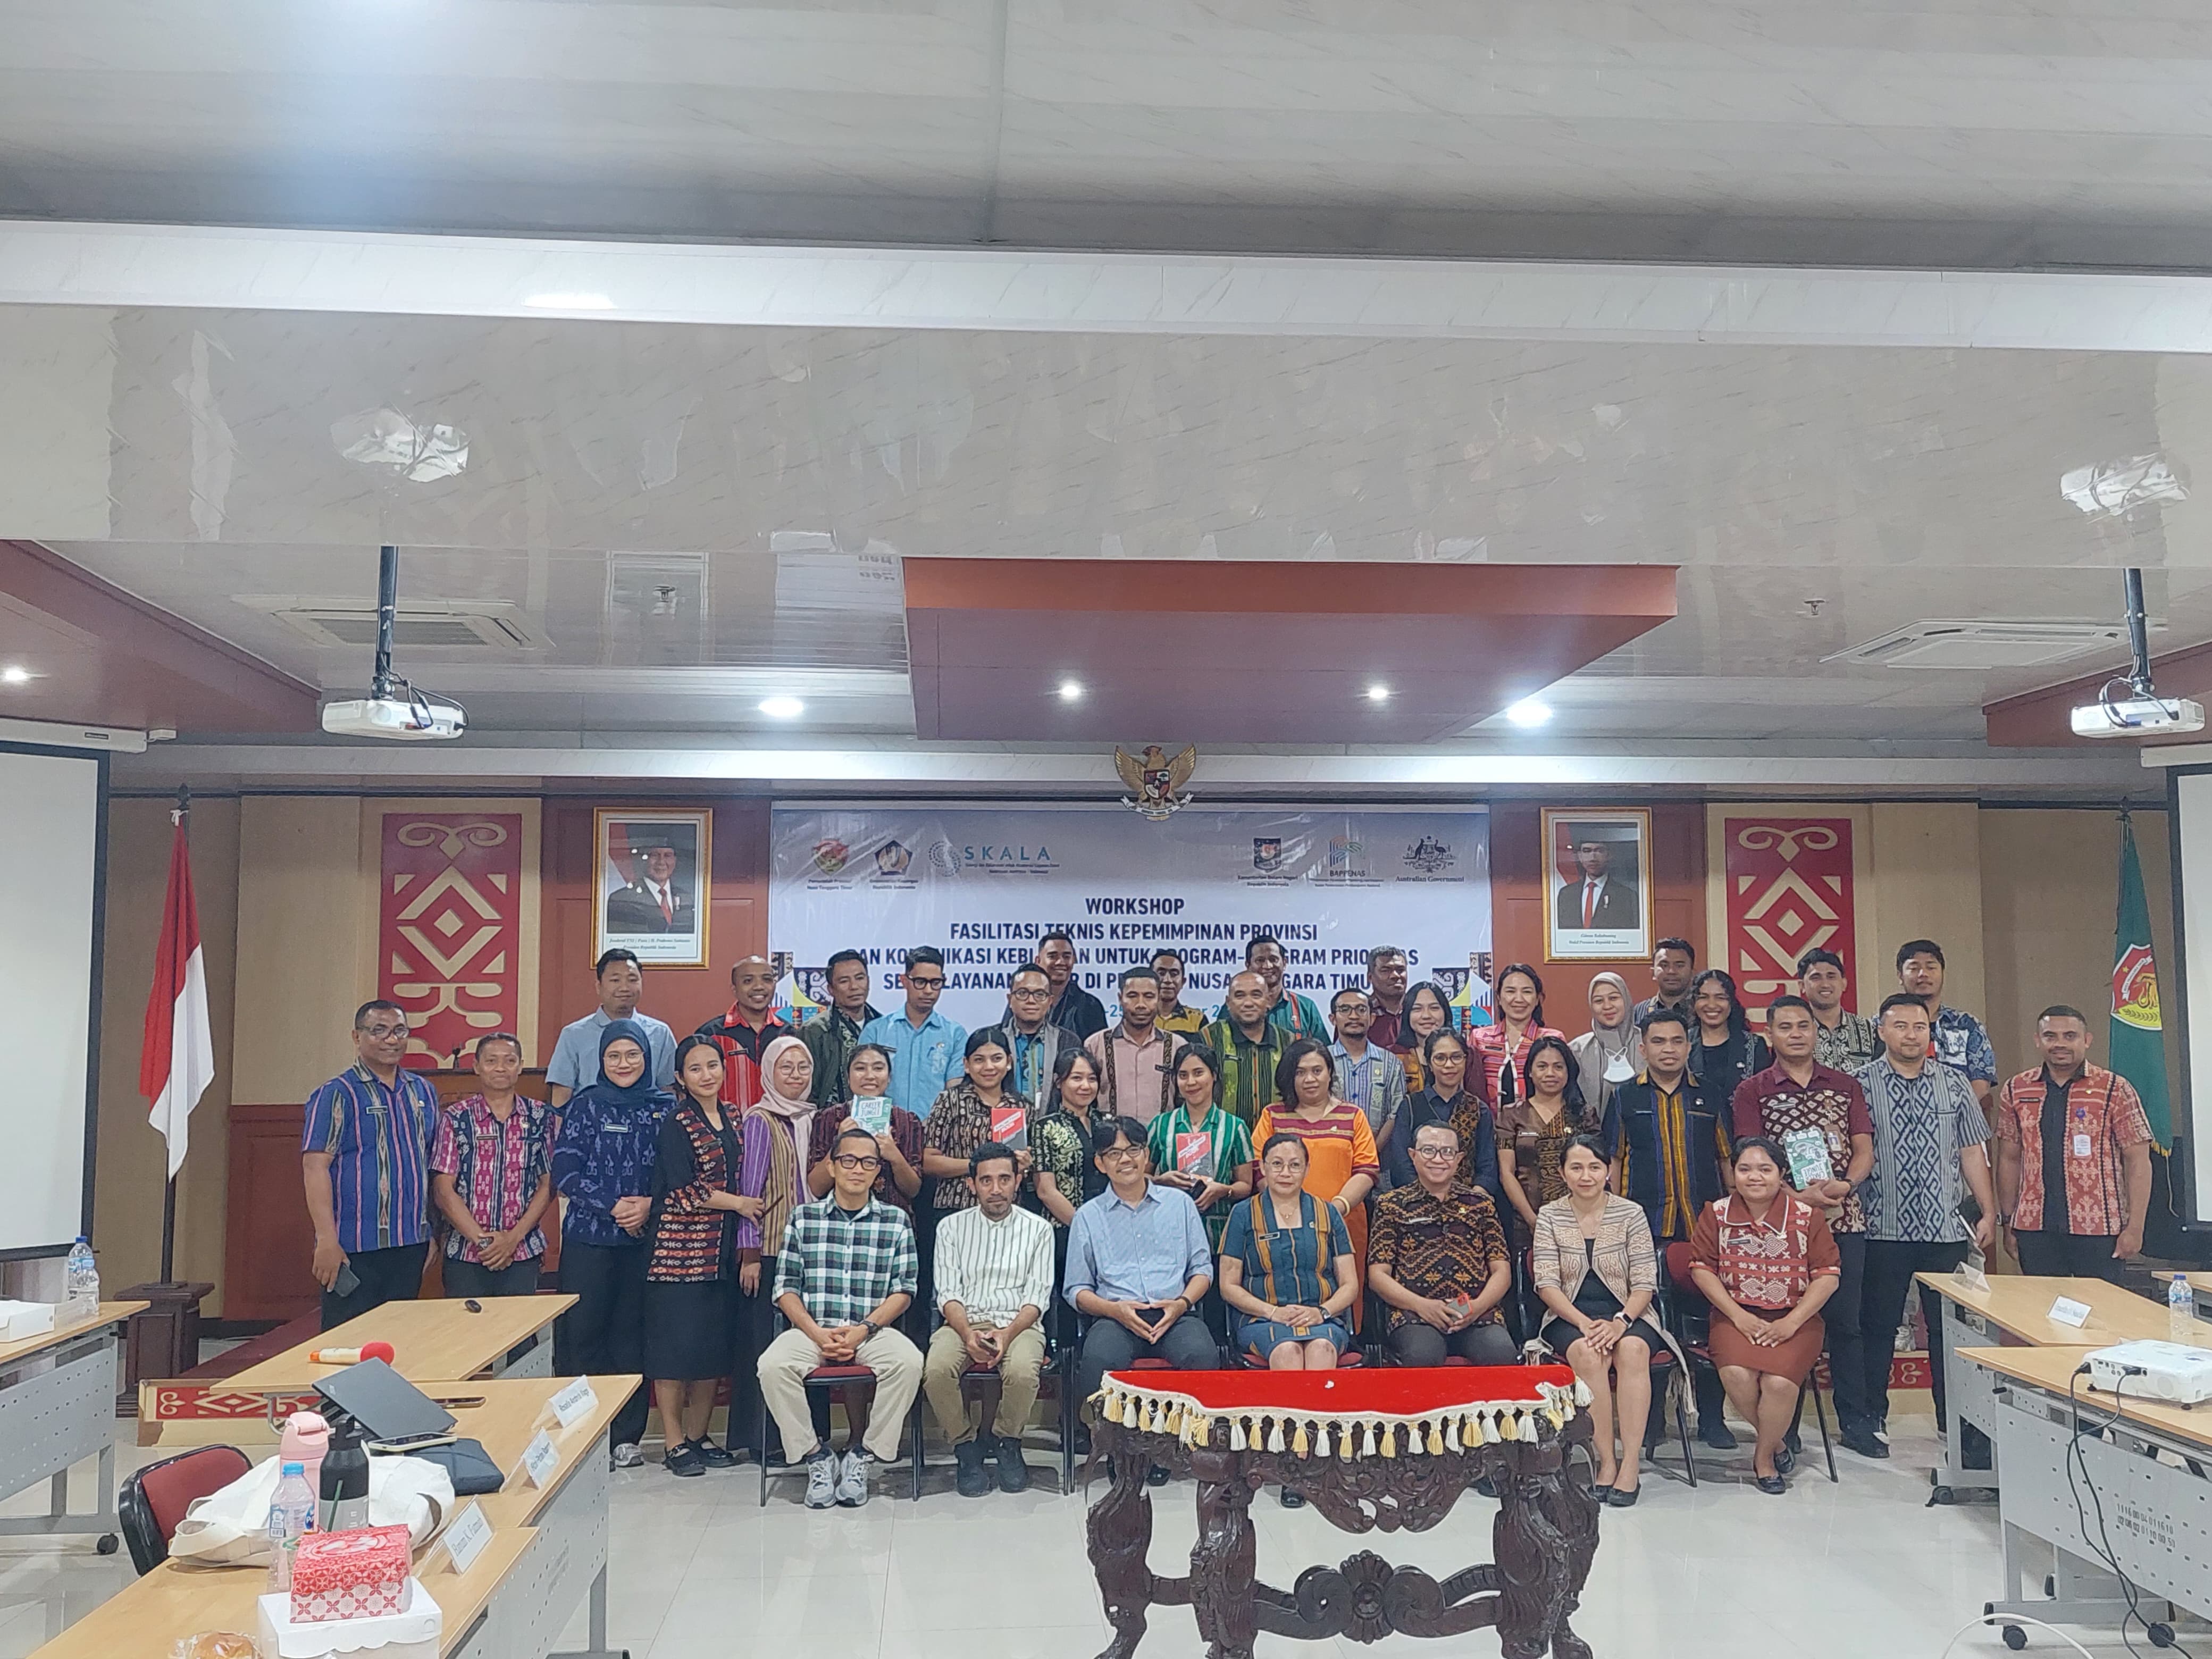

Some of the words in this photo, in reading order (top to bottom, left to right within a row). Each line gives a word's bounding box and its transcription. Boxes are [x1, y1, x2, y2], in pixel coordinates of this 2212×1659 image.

[964, 847, 1050, 860] SKALA
[1085, 898, 1184, 915] WORKSHOP
[950, 923, 1039, 940] FASILITASI
[1045, 924, 1104, 940] TEKNIS
[1110, 924, 1234, 940] KEPEMIMPINAN
[1240, 924, 1317, 940] PROVINSI
[854, 949, 881, 964] AN
[886, 948, 991, 964] KONIKASI
[997, 948, 1090, 964] KEBIN
[1095, 948, 1150, 964] UNTUK
[1331, 949, 1419, 965] PRIOS
[942, 973, 1012, 989] LAYANA
[1086, 973, 1100, 989] DI
[1189, 973, 1231, 989] NUSA
[1330, 974, 1370, 990] TIMU
